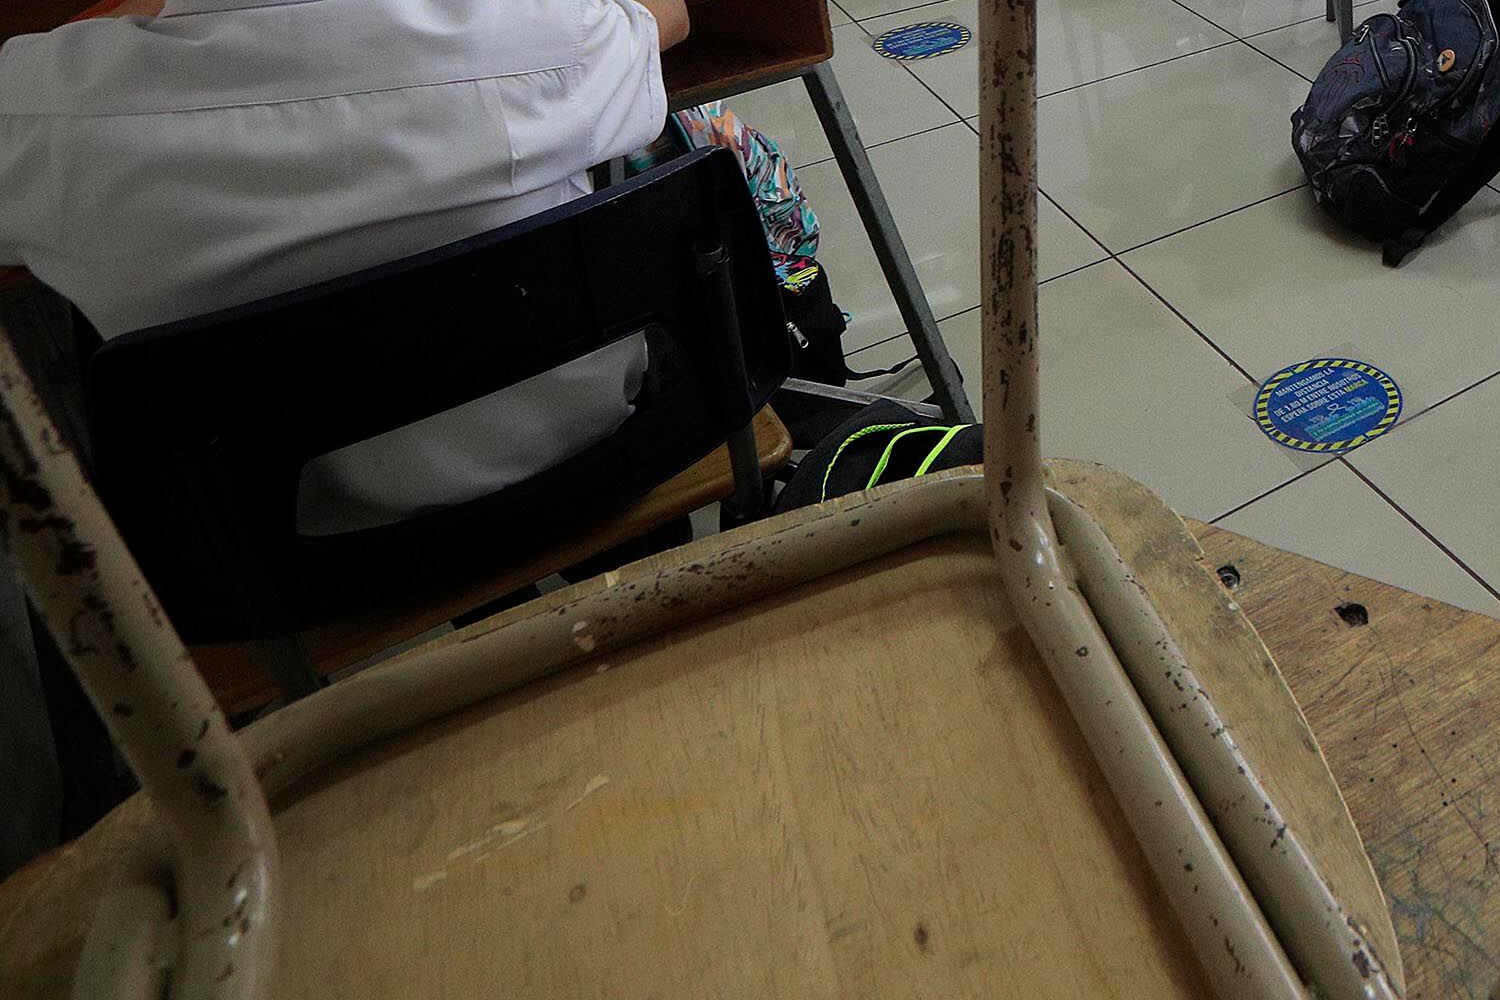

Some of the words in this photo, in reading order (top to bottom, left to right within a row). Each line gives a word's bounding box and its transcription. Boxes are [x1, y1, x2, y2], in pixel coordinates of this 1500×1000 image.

[1275, 372, 1326, 397] MANTENGAMOS
[1323, 368, 1335, 378] LA
[1294, 379, 1330, 398] DISTANCIA
[1273, 408, 1287, 417] DE
[1280, 406, 1310, 423] ESPERA
[1327, 389, 1347, 401] ESTA
